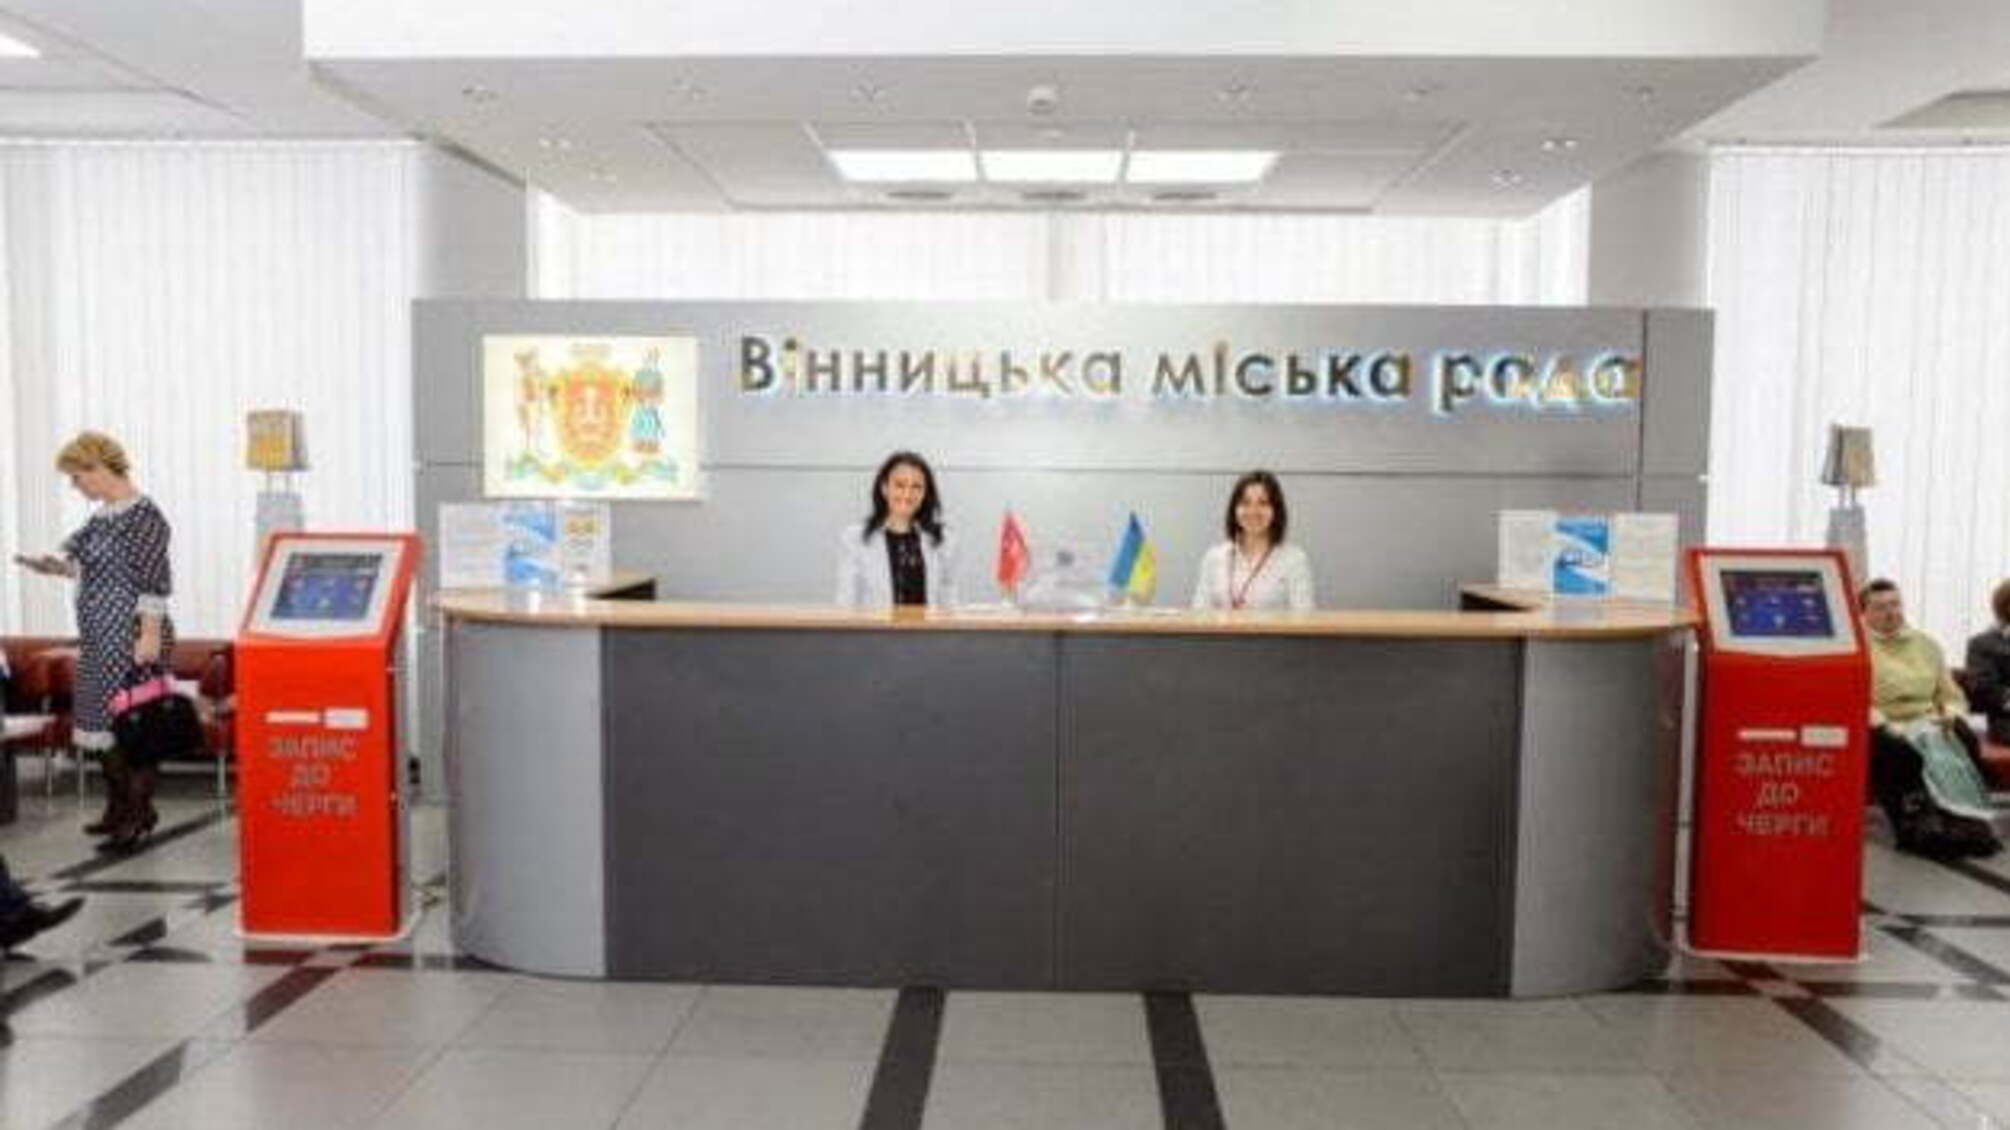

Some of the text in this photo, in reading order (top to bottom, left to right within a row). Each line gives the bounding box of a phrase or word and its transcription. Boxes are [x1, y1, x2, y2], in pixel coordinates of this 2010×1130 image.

[740, 336, 1643, 413] Вінницька міська рада
[1735, 753, 1834, 777] ЗАПИС
